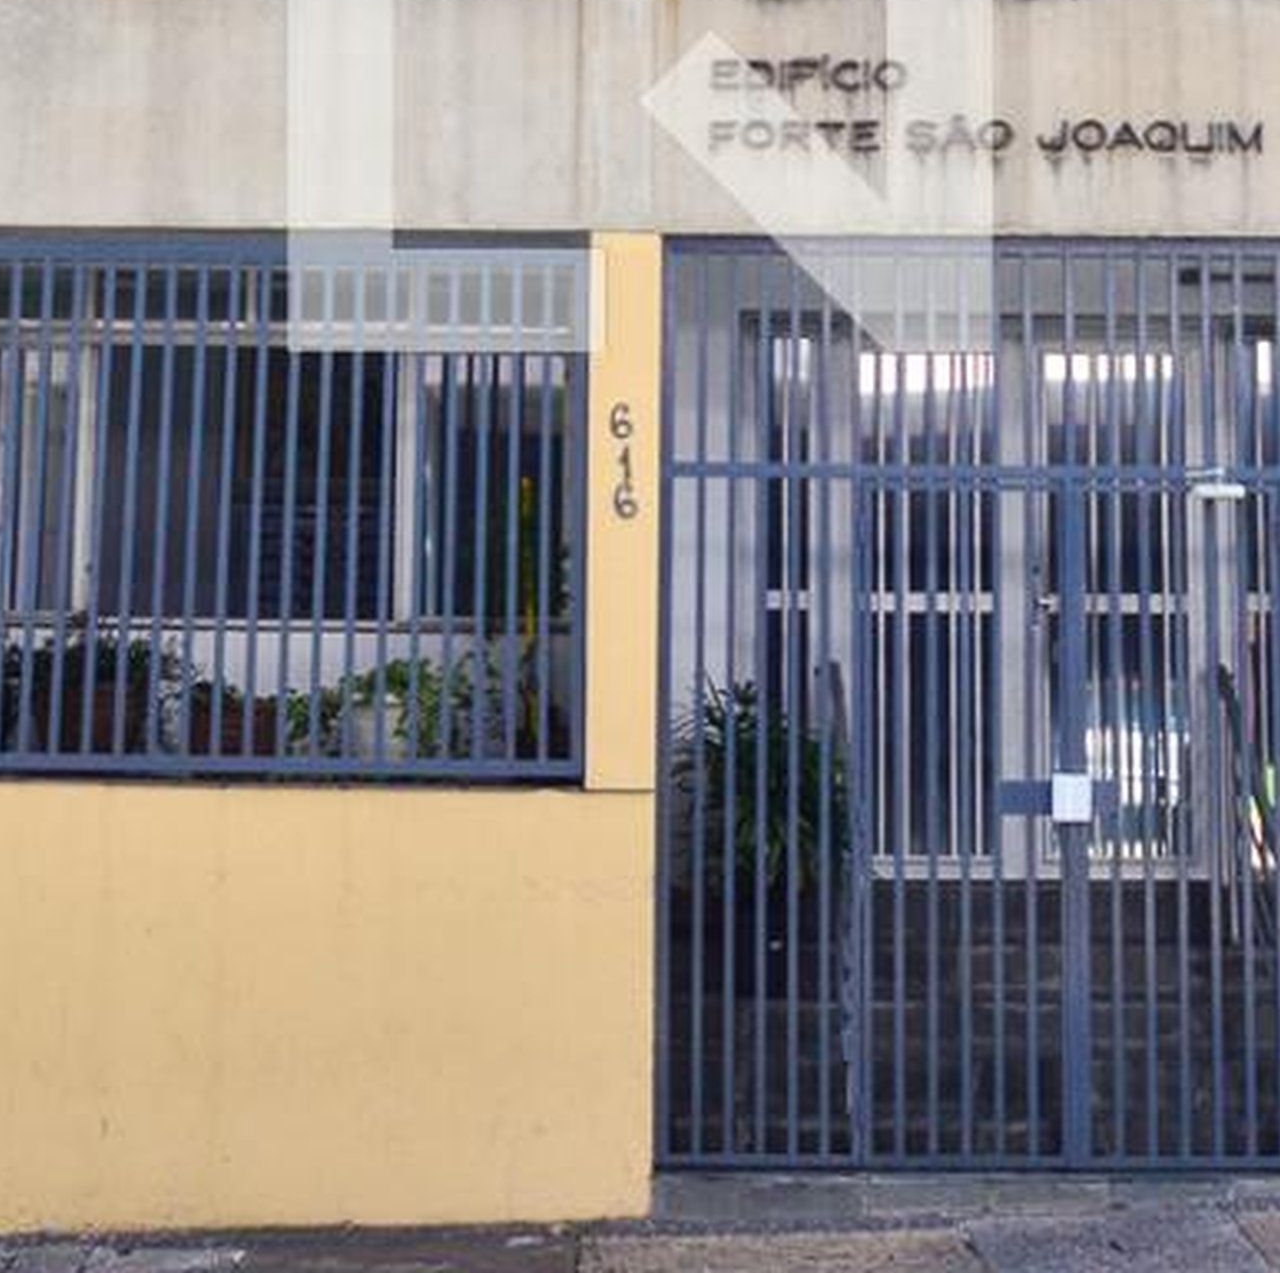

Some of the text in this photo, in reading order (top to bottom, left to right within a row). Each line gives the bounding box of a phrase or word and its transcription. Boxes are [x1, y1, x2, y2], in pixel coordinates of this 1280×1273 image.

[709, 53, 907, 92] EDIFÍCIO
[709, 113, 1263, 155] FORTE SÃO JOAQUIM
[610, 402, 638, 519] 616
